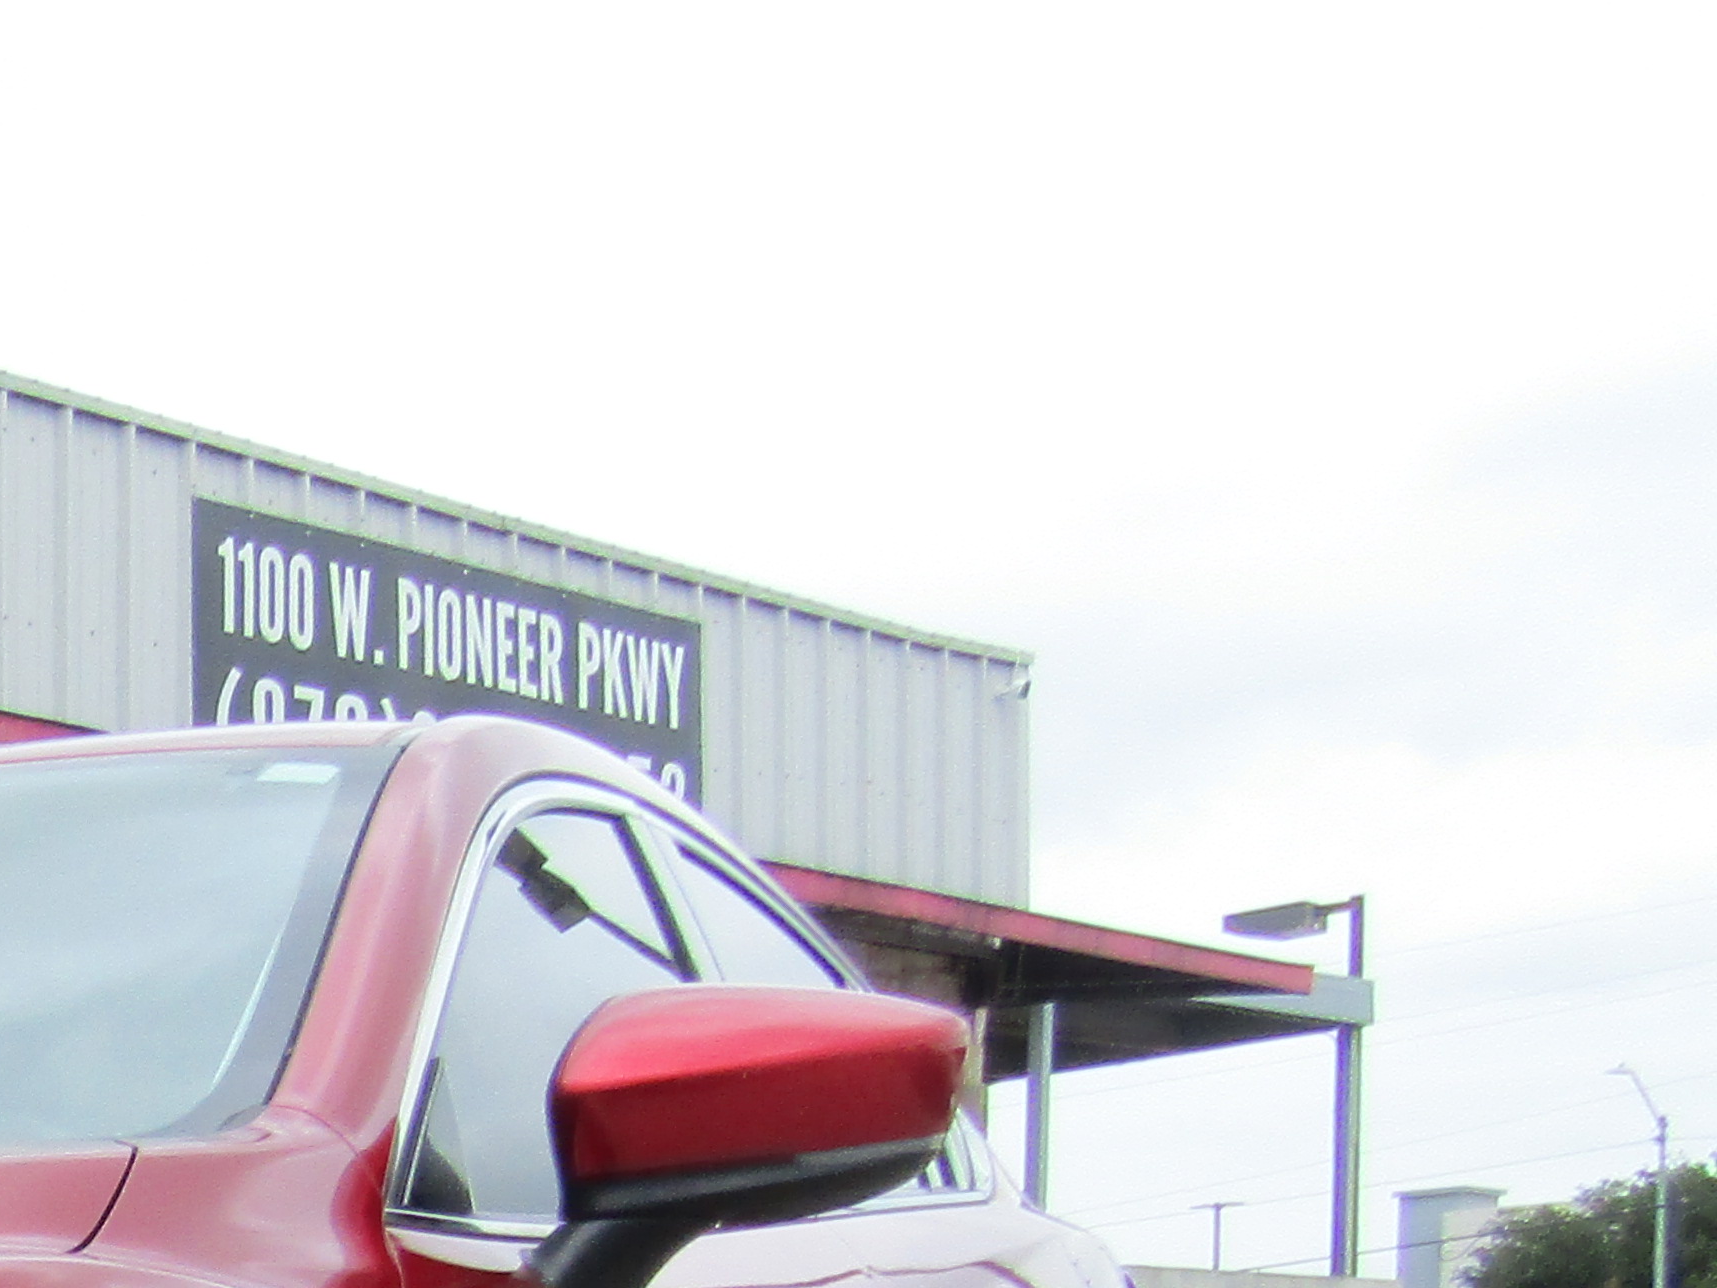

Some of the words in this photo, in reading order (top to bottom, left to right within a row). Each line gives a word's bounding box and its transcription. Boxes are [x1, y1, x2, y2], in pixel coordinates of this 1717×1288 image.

[217, 536, 315, 652] 1100
[328, 561, 386, 665] W.
[397, 577, 565, 705] PIONEER
[578, 621, 686, 730] PKWY
